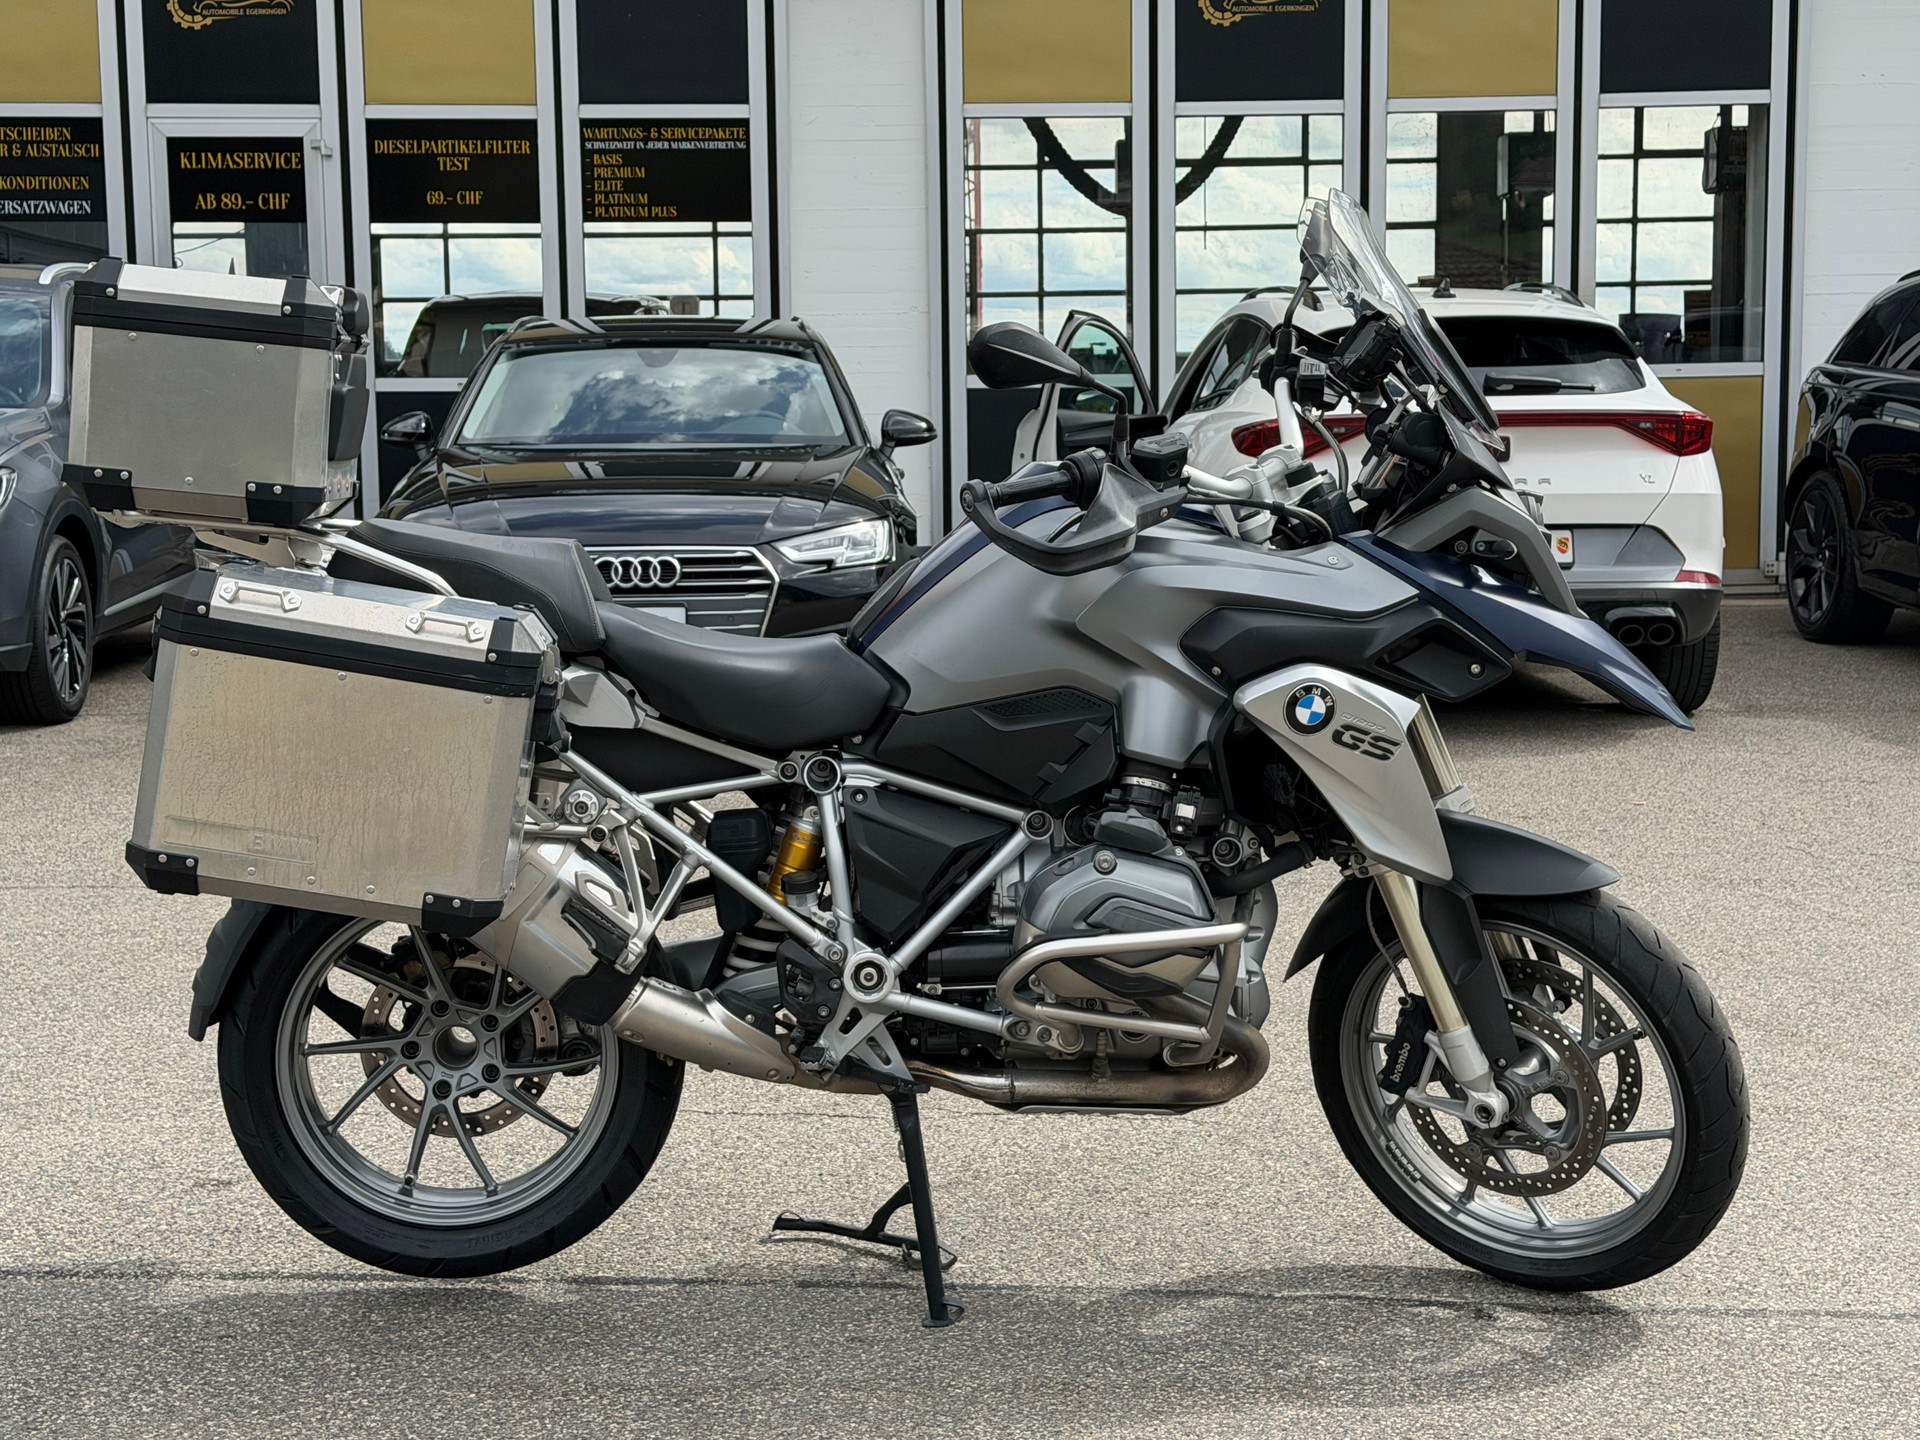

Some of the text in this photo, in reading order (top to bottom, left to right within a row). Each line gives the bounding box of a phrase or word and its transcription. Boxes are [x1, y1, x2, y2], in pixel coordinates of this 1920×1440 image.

[1274, 4, 1315, 12] EGERKINGEN
[583, 127, 747, 139] WARTUNGS- & SERVICEPAKETE
[12, 143, 21, 157] &
[25, 143, 100, 157] AUSTAUSCH
[374, 139, 531, 155] DIESELPARTIKELFILTER
[645, 140, 670, 150] JEDER
[180, 151, 302, 169] KLIMASERVICE
[437, 156, 471, 171] TEST
[593, 153, 623, 165] BASIS
[593, 166, 646, 178] PREMIUM
[0, 175, 89, 190] KONDITIONEN
[594, 180, 624, 191] ELITE
[195, 192, 291, 210] AB 89.- CHF
[426, 190, 484, 205] 69.- CHF
[594, 193, 648, 205] PLATINUM
[594, 206, 649, 218] PLATINUM
[651, 206, 678, 218] PLUS
[1295, 686, 1334, 708] BMW
[1331, 723, 1404, 763] GS
[1389, 1042, 1411, 1083] brembo
